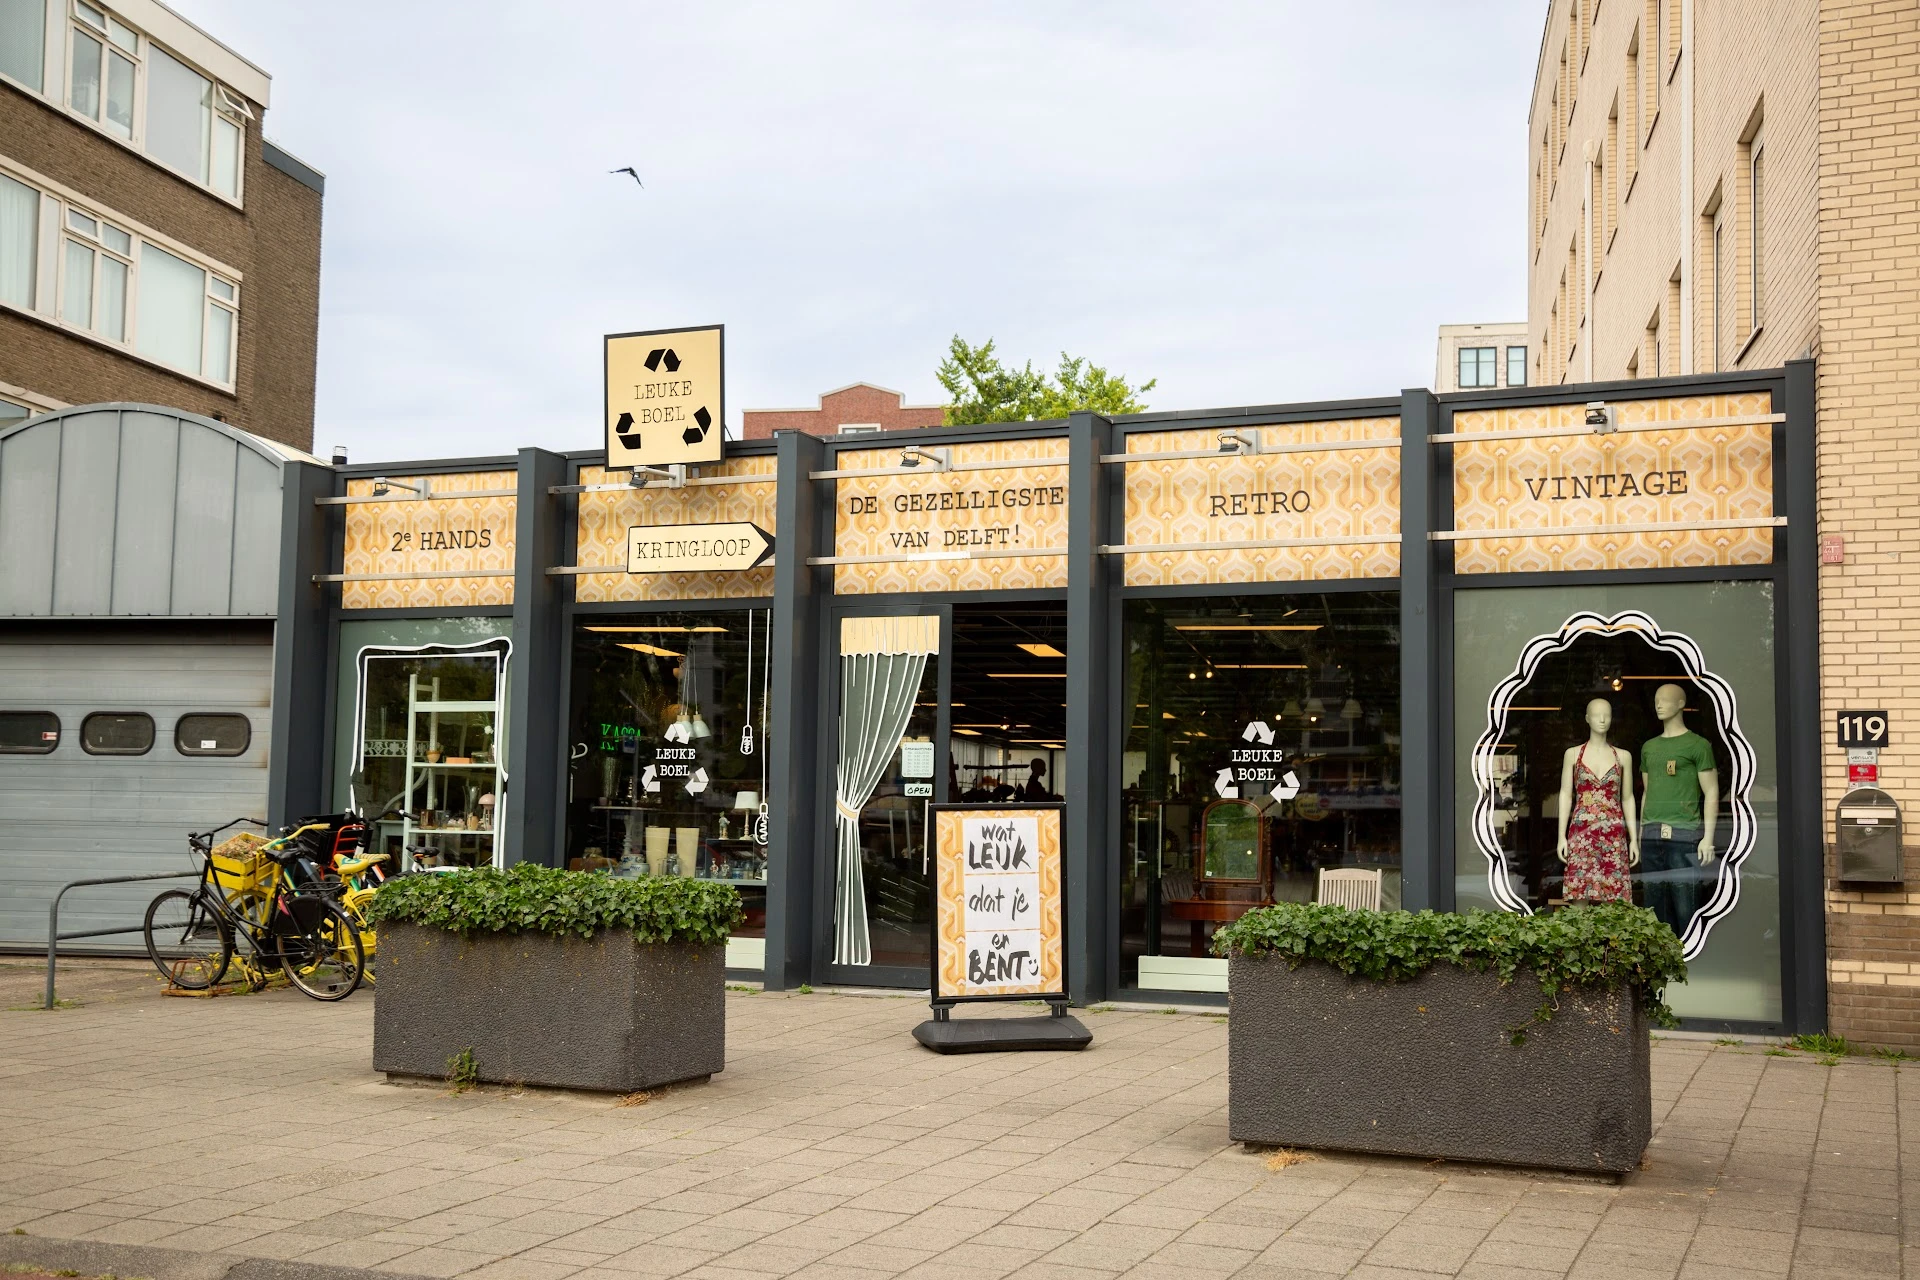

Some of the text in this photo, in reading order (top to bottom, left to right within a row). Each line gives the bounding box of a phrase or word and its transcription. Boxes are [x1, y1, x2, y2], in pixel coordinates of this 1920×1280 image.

[634, 381, 692, 400] LEUKE
[641, 406, 685, 424] BOEL
[1524, 471, 1688, 501] VINTAGE
[850, 486, 1064, 514] DE GEZELLIGSTE
[1210, 490, 1310, 517] RETRO
[420, 529, 491, 550] HANDS
[890, 524, 1020, 548] VAN DELFT!
[636, 538, 751, 559] KRINGLOOP
[1839, 716, 1886, 741] 119
[655, 748, 696, 760] LEUKE
[1231, 749, 1283, 762] LEUKE
[659, 764, 690, 777] BOEL
[1237, 767, 1276, 781] BOEL
[907, 787, 931, 795] OPEN
[981, 820, 1016, 842] wat
[968, 836, 1032, 870] LEUK
[968, 884, 1030, 922] dat je
[991, 933, 1011, 951] er
[968, 949, 1031, 985] BENT
